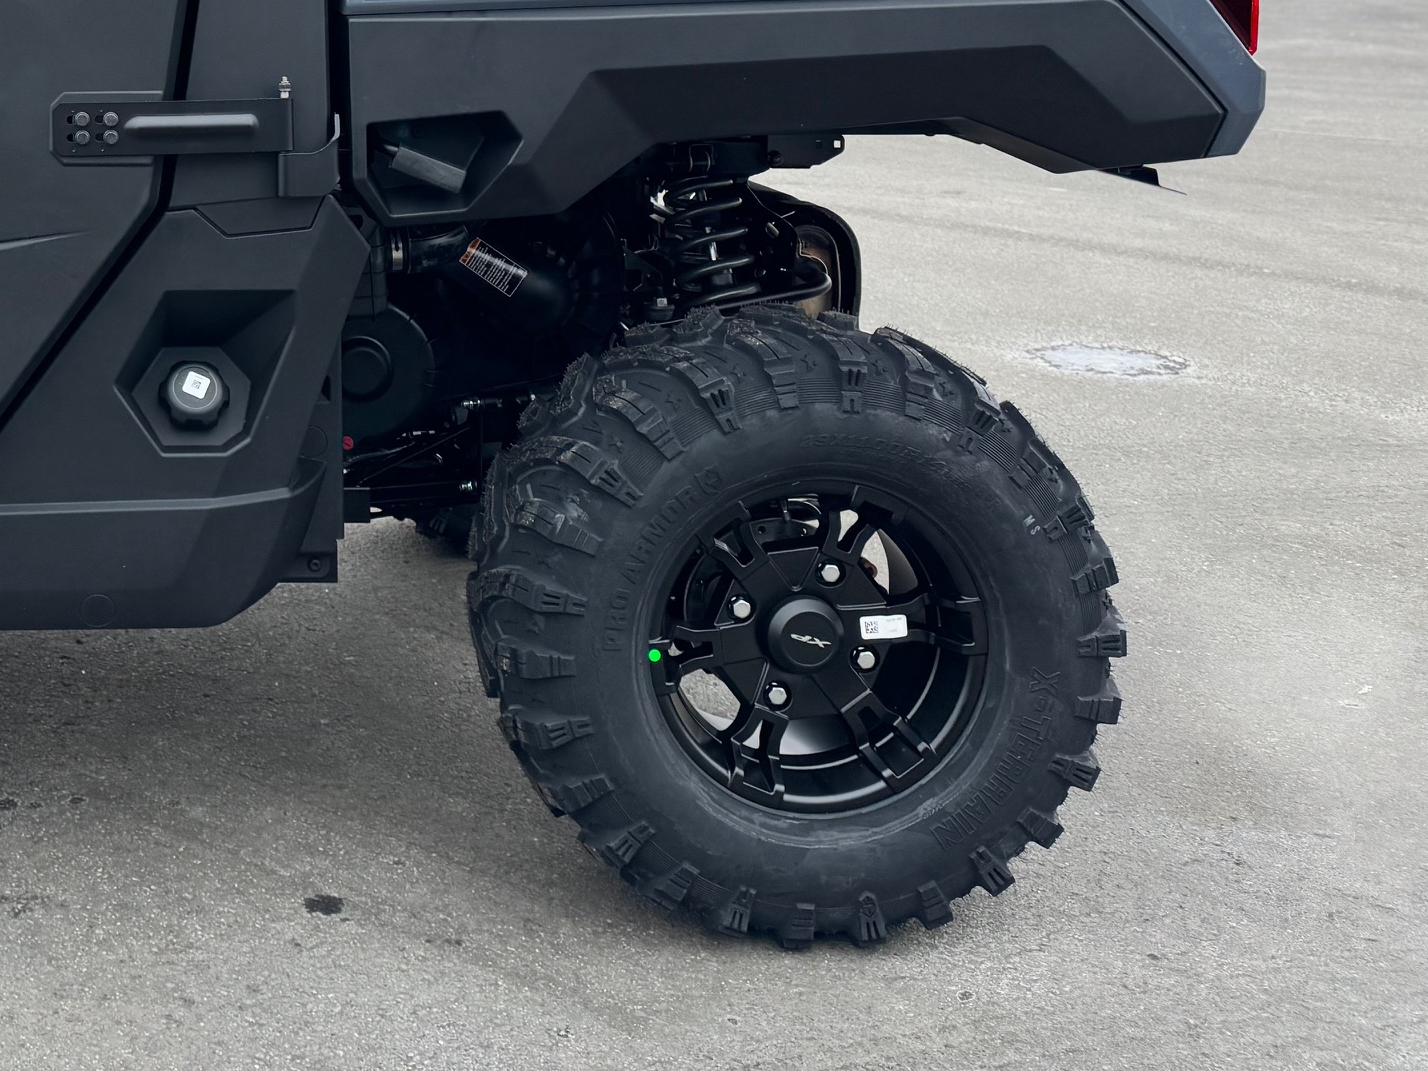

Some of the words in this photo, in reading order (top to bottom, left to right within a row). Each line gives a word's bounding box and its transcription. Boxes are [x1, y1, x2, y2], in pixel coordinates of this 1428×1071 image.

[603, 588, 630, 651] PRO
[620, 485, 697, 586] ARMOR
[929, 665, 1061, 851] X-TERRAIN
